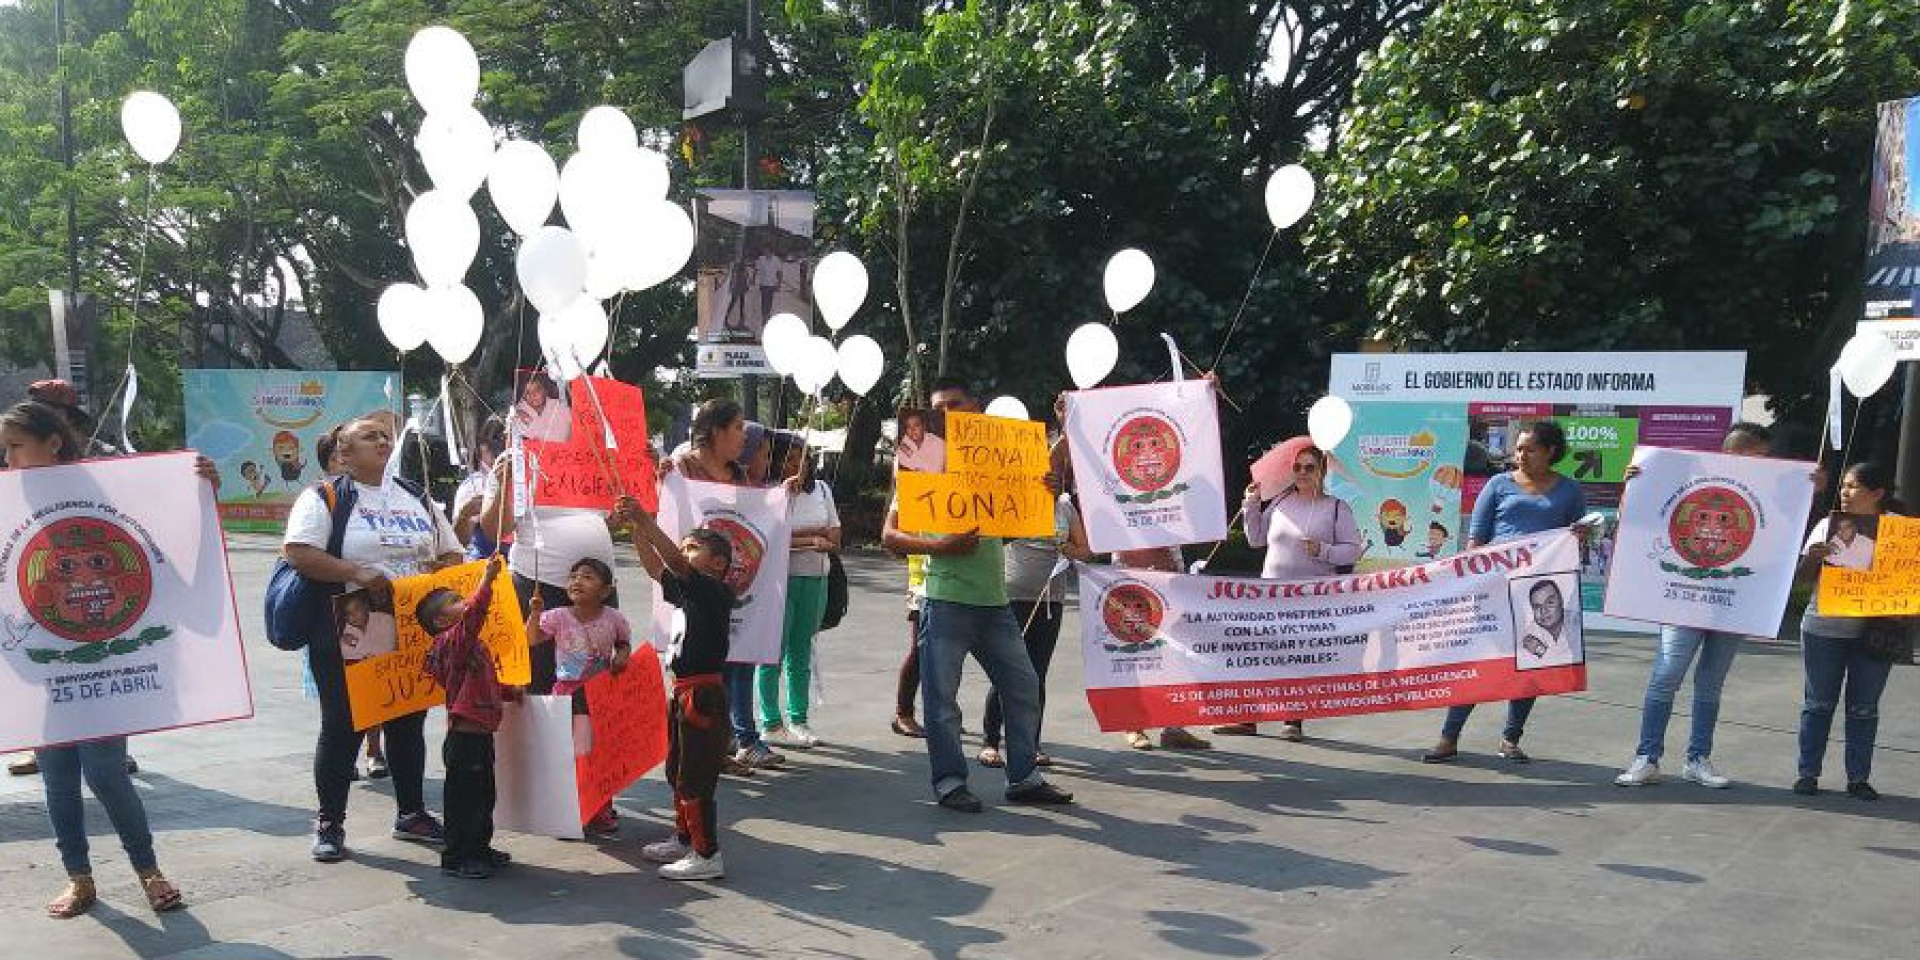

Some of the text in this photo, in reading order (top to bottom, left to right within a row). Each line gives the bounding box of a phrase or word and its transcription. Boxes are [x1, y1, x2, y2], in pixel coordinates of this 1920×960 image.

[1405, 371, 1655, 391] EL GOBIERNO DEL ESTADO INFORMA
[1565, 426, 1618, 440] 100%
[97, 503, 118, 517] POR
[1206, 579, 1345, 600] JUSTICIA
[1664, 589, 1733, 607] 25 DE ABRIL
[1205, 609, 1275, 623] AUTORIDAD
[1277, 607, 1332, 621] PREFIERE
[1335, 603, 1375, 618] LIDIAR
[1224, 626, 1250, 637] CON
[1254, 624, 1277, 637] LAS
[1192, 633, 1368, 654] QUE INVESTIGAR Y CASTIGAR
[1226, 656, 1235, 668] A
[1237, 655, 1260, 667] LOS
[51, 673, 162, 703] 25 DE ABRIL
[1188, 690, 1204, 701] DE
[1207, 688, 1241, 700] ABRIL
[1266, 685, 1282, 697] DE
[1283, 684, 1305, 696] LAS
[1365, 679, 1380, 690] DE
[1382, 677, 1398, 688] LA
[1400, 668, 1479, 687] NEGLIGENCIA
[1199, 704, 1225, 717] POR
[1226, 700, 1309, 716] AUTORIDADES
[1310, 699, 1318, 709] Y
[1319, 694, 1392, 710] SERVIDORES
